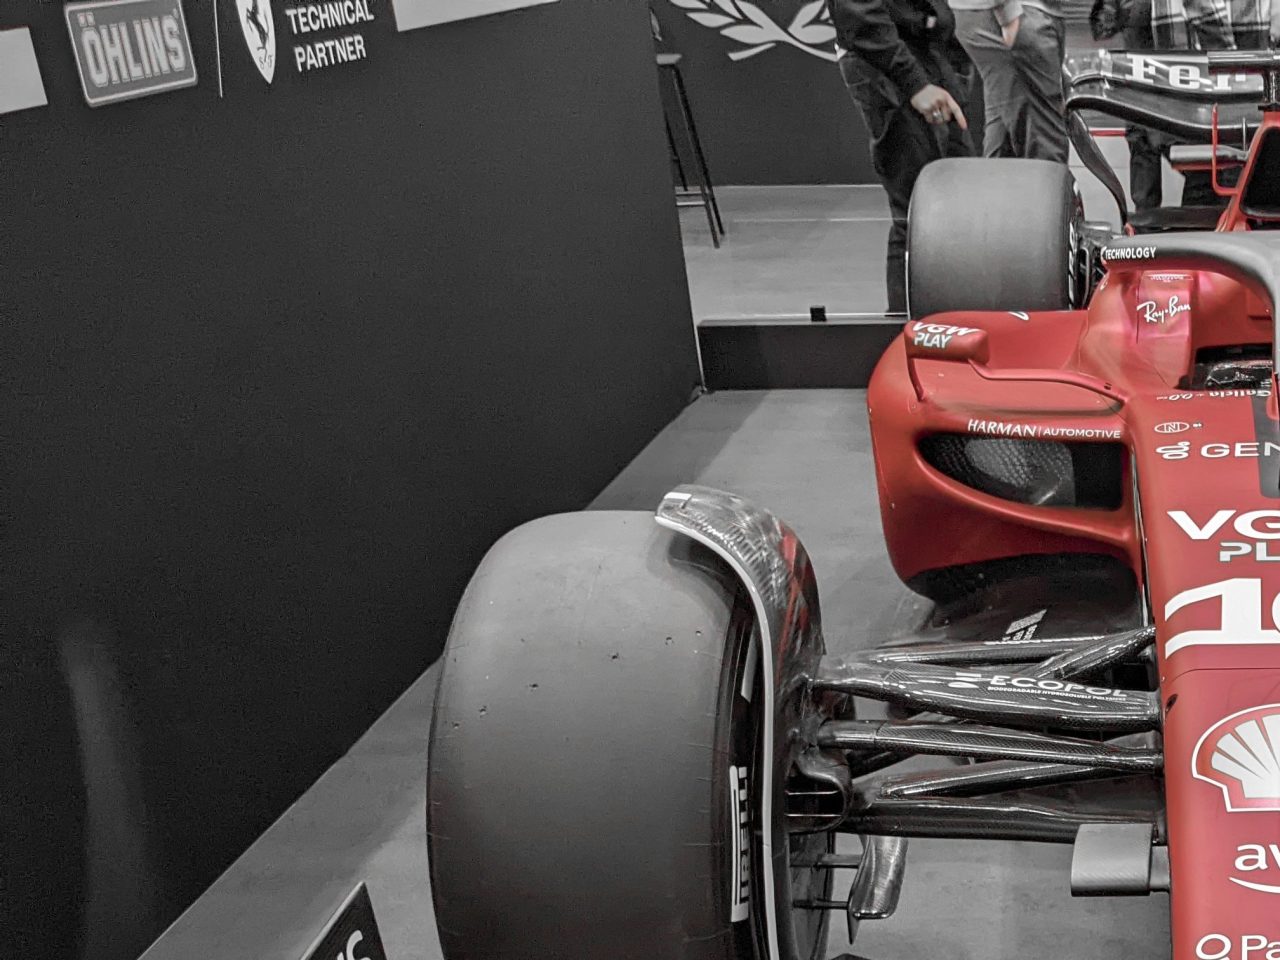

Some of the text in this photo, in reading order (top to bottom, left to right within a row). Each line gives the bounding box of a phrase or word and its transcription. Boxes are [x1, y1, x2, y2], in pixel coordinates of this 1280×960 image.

[285, 0, 374, 34] TECHNICAL
[77, 12, 186, 87] ÖHLINS
[294, 35, 367, 72] PARTNER
[1105, 246, 1157, 260] TECHNOLOGY
[913, 321, 982, 337] VGW
[914, 331, 952, 349] PLAY
[967, 418, 1121, 439] HARMAN AUTOMOTIVE
[990, 675, 1128, 698] ECOPOL
